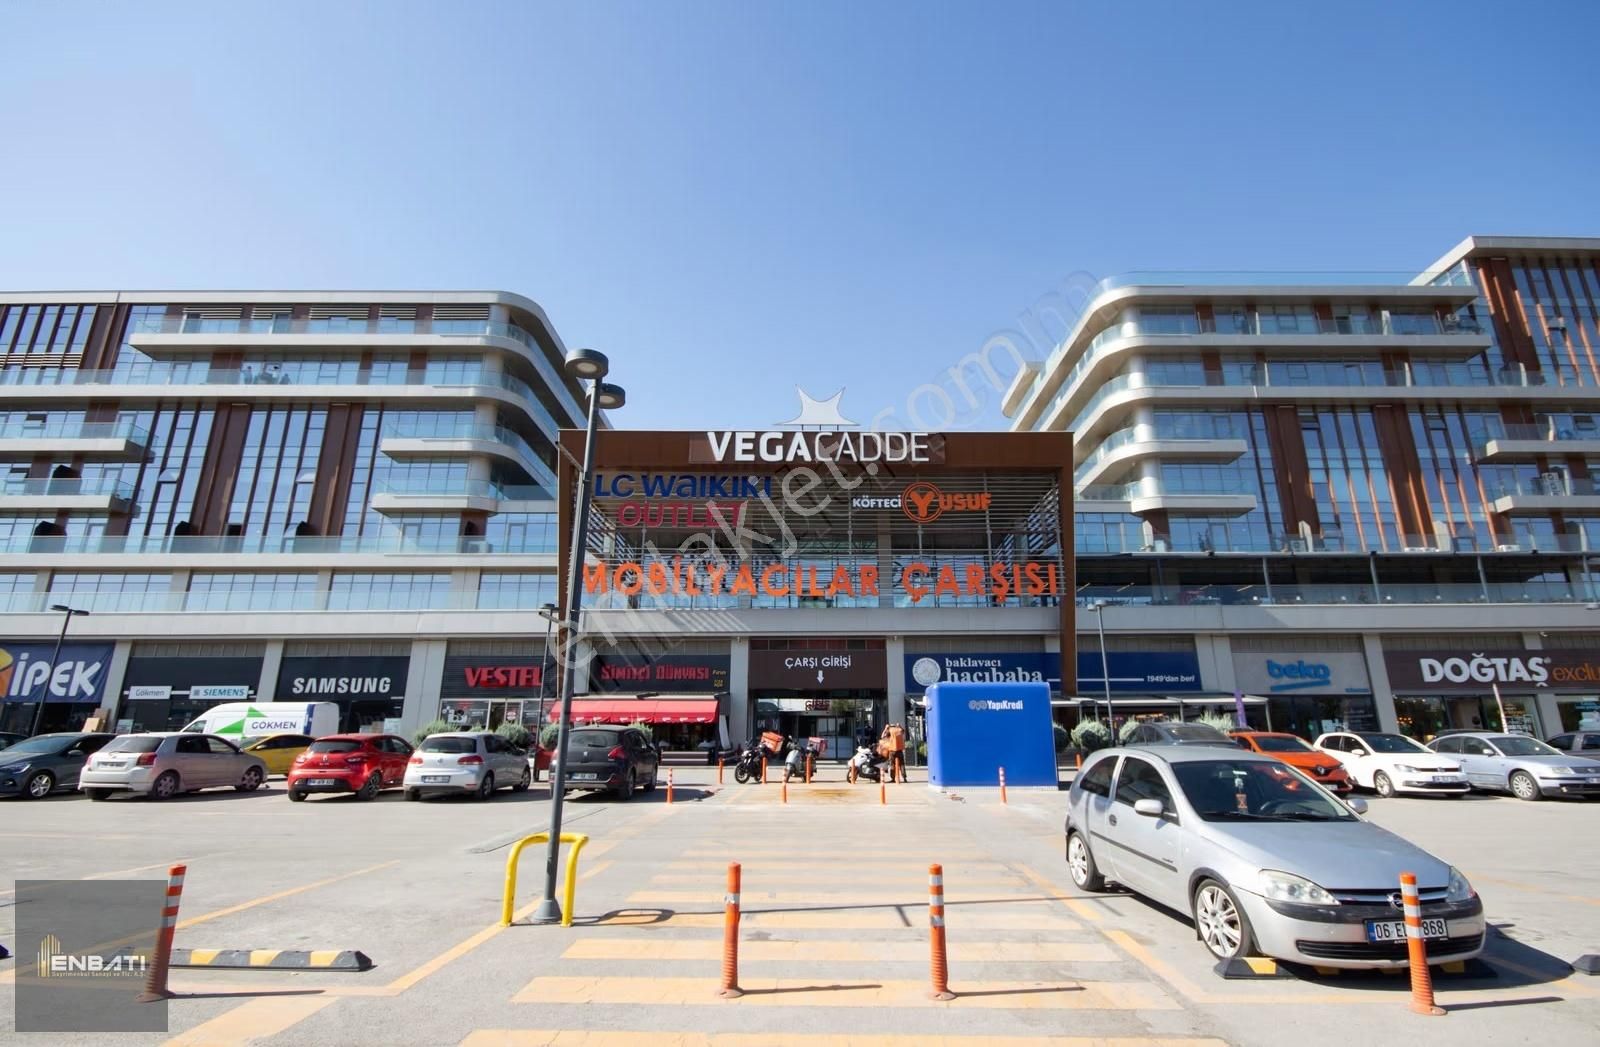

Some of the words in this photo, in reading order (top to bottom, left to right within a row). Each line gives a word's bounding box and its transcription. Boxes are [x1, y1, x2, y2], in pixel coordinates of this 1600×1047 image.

[707, 431, 930, 462] VEGACADDE
[594, 474, 634, 498] LC
[617, 501, 749, 528] OUTLET
[582, 554, 880, 598] MOBİLYACILAR
[902, 562, 1058, 604] ÇARŞISI
[785, 657, 818, 669] ÇARŞI
[821, 655, 851, 669] GİRİŞİ
[945, 657, 1001, 668] baklavacı
[1266, 659, 1331, 680] beko
[1419, 653, 1549, 687] DOĞTAŞ
[292, 677, 392, 694] SAMSUNG
[464, 666, 543, 688] VESTEL
[945, 667, 1043, 683] hacıbaba
[203, 688, 246, 697] SIEMENS
[1375, 924, 1391, 939] 06
[1423, 920, 1445, 936] 868
